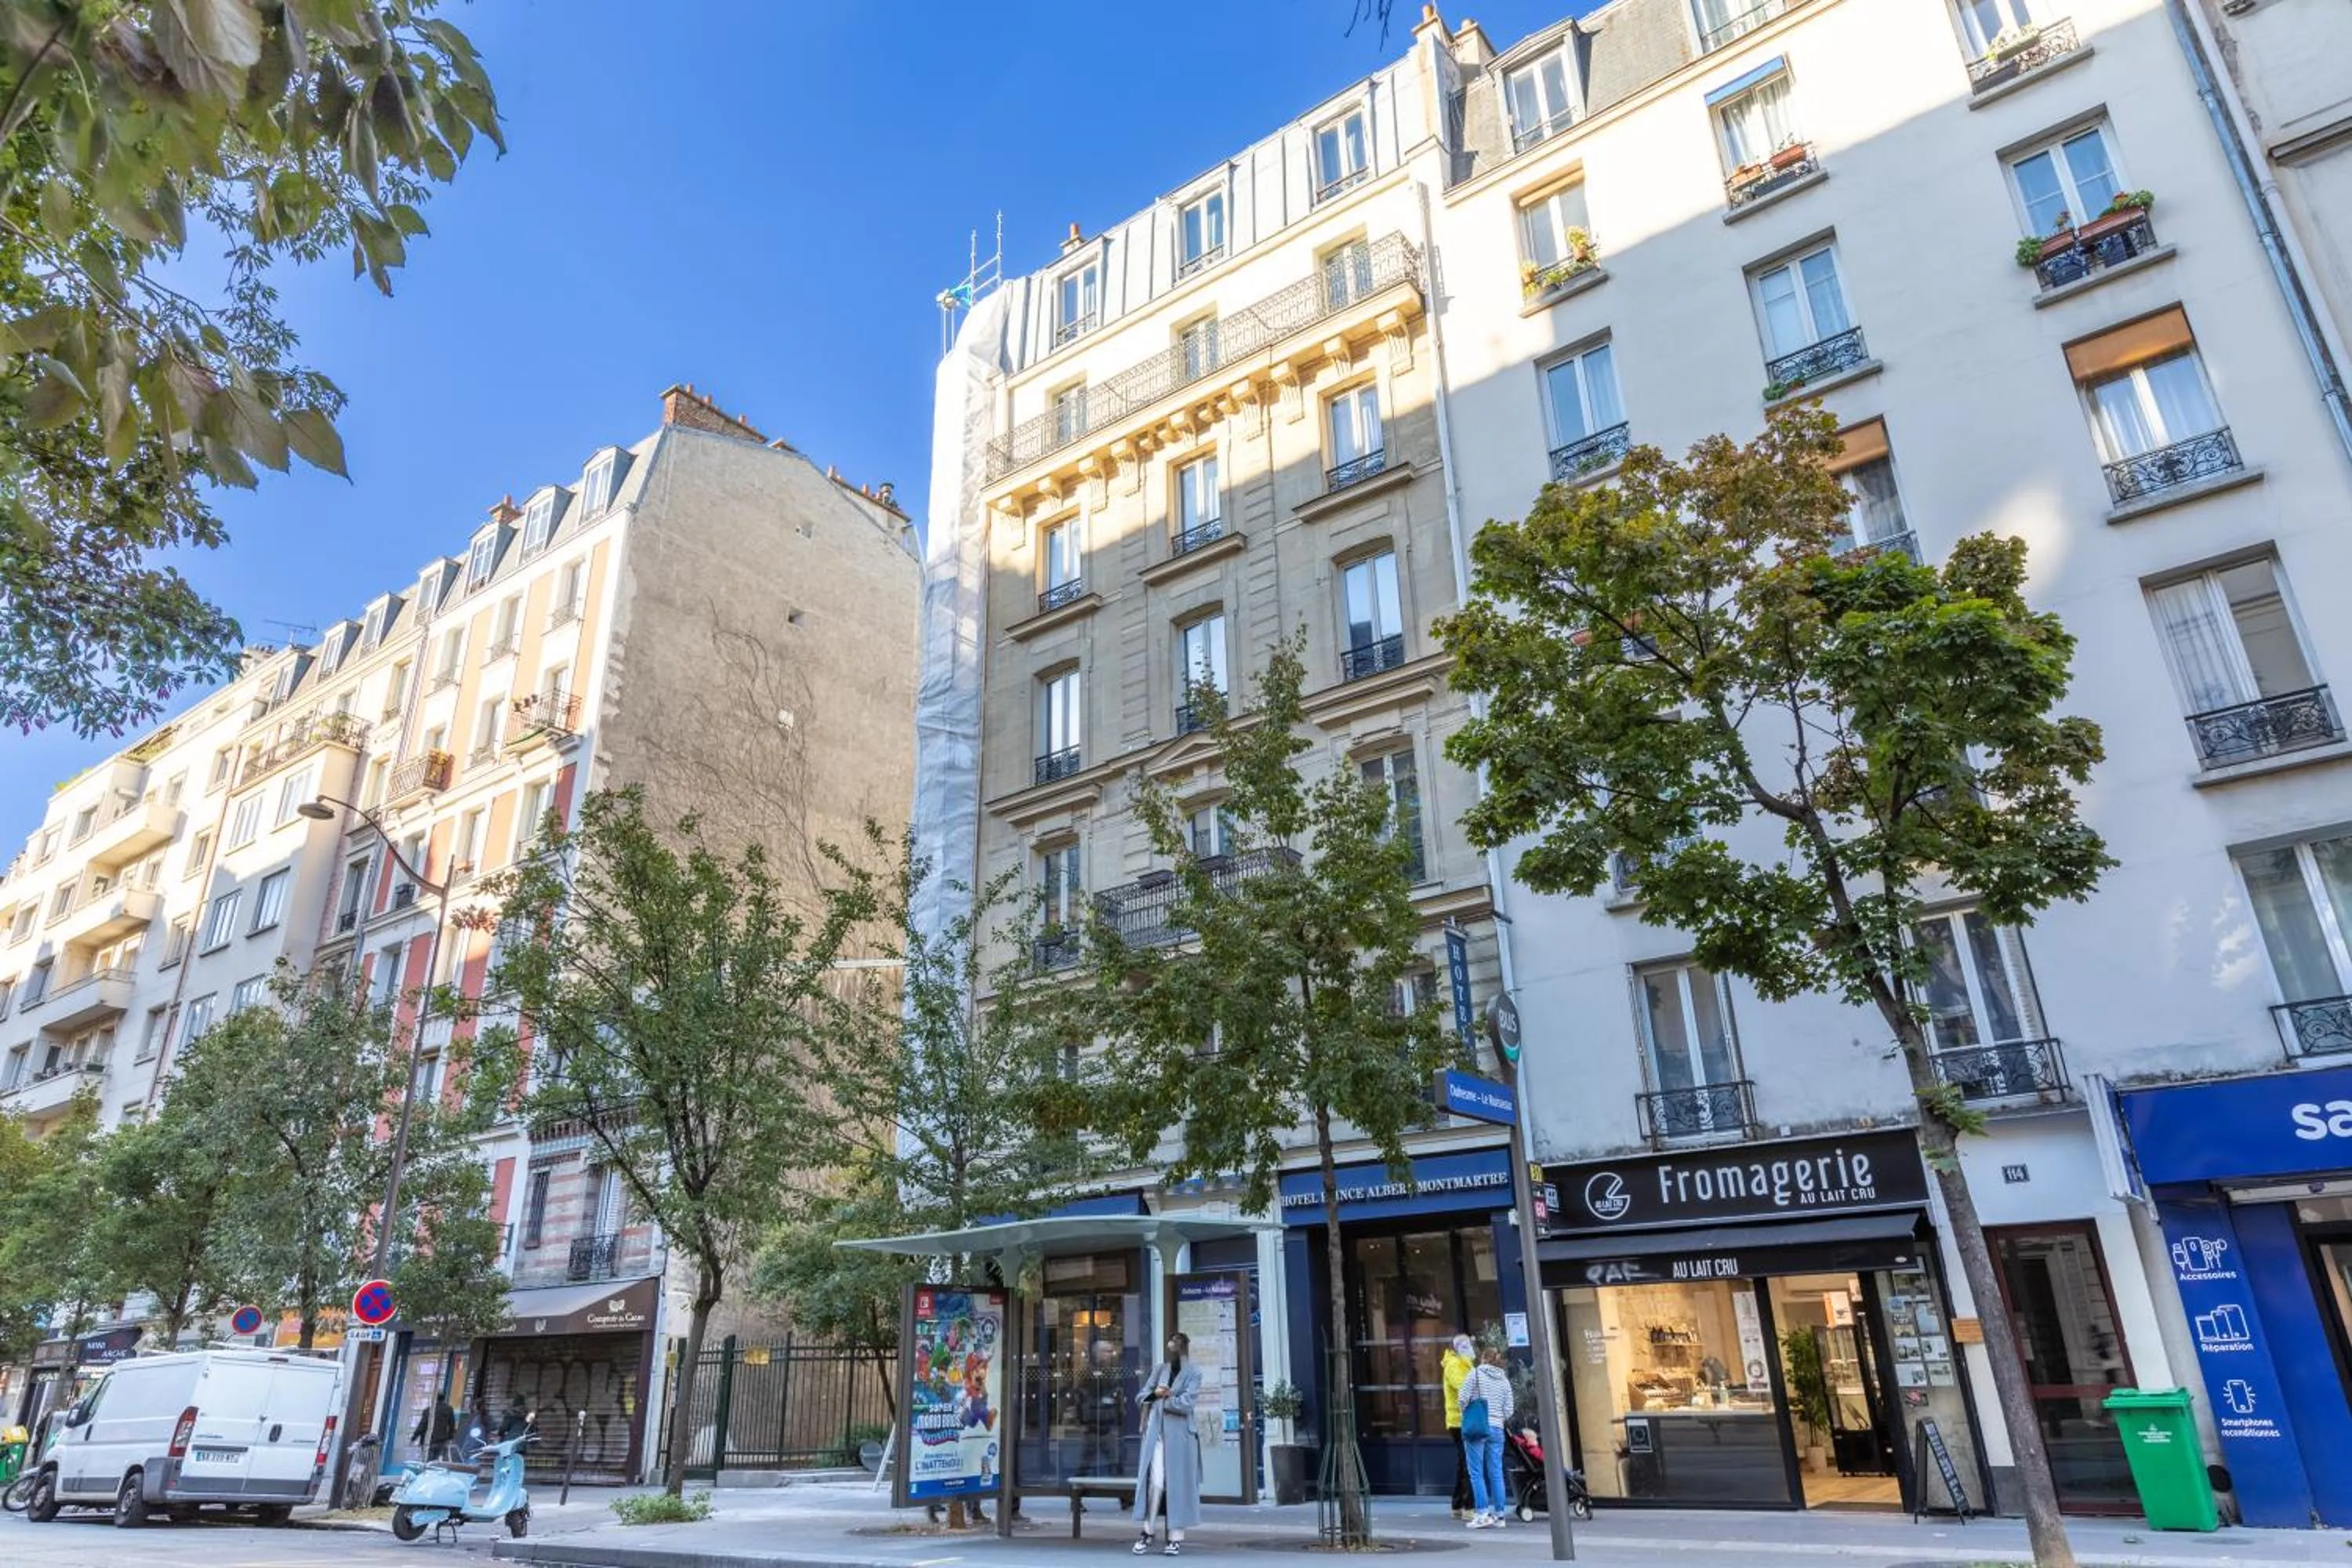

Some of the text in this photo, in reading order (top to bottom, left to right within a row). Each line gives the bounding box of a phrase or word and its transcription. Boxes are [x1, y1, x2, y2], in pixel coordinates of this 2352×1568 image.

[1498, 1009, 1518, 1033] BUS
[1658, 1149, 1872, 1206] Fromagerie
[2007, 1167, 2024, 1180] 114
[1280, 1192, 1318, 1207] HOTEL
[1417, 1171, 1508, 1192] MONTMARTRE
[1800, 1186, 1876, 1204] AU LAIT CRU
[1672, 1258, 1738, 1279] AU LAIT CRU
[2179, 1271, 2238, 1281] Accessoires
[2221, 1417, 2274, 1428] Smartphones
